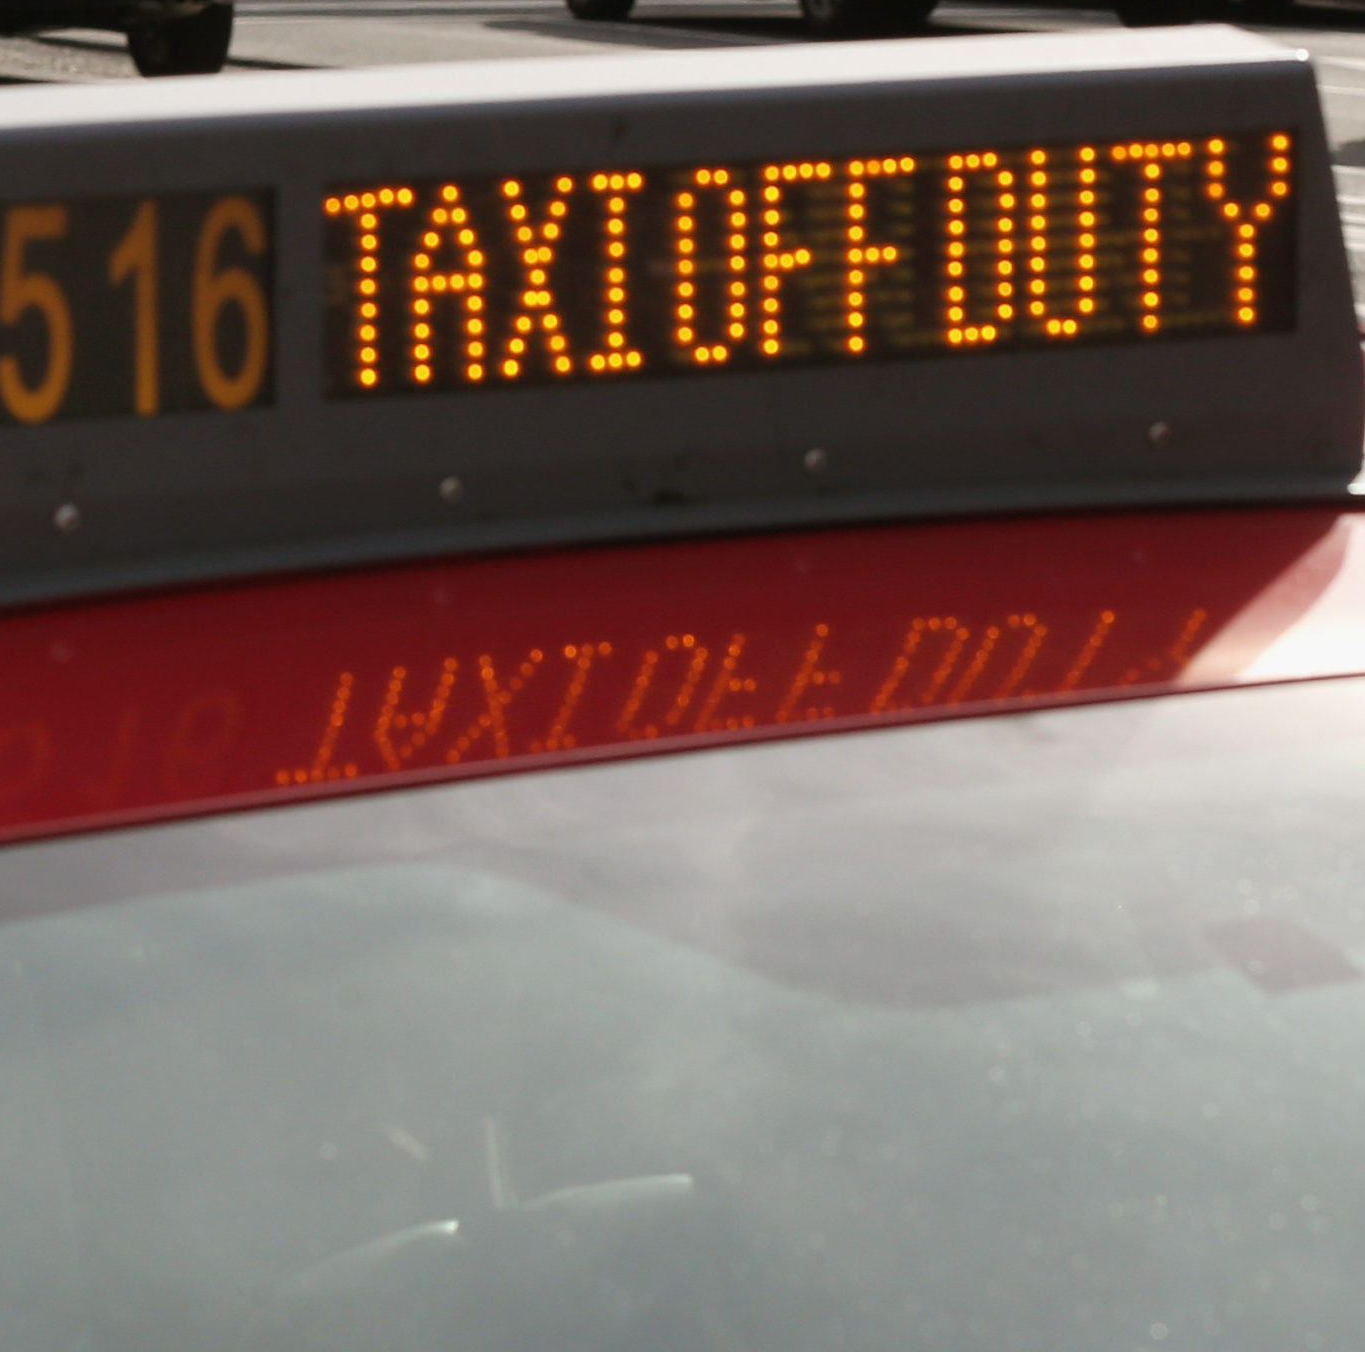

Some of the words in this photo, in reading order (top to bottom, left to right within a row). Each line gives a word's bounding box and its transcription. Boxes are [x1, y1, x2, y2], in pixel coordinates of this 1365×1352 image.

[325, 171, 644, 387] TAXI
[676, 156, 916, 364] OFF
[946, 134, 1289, 345] DUTY
